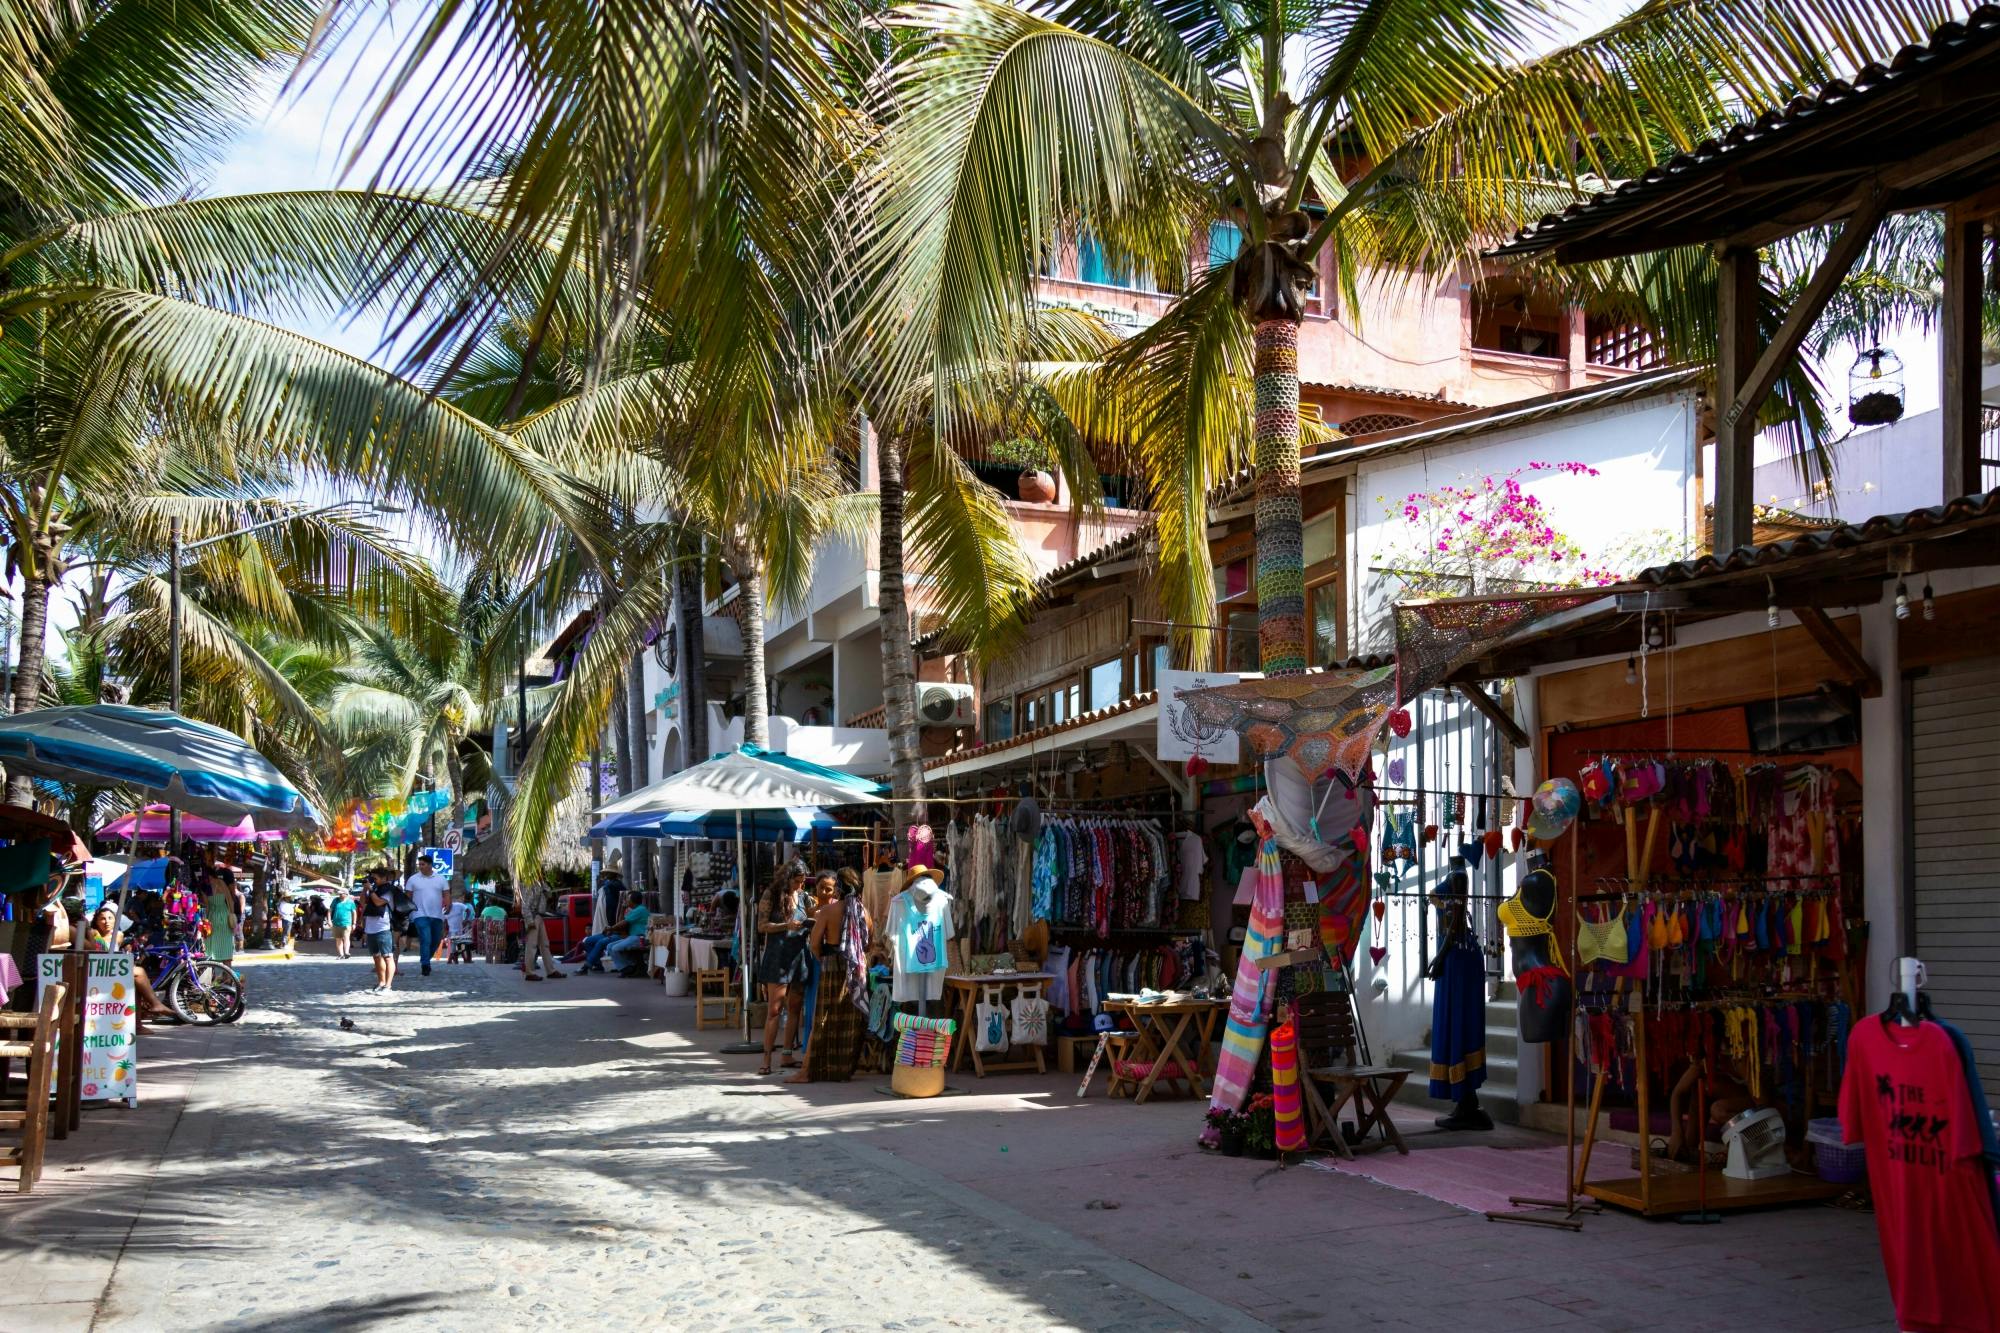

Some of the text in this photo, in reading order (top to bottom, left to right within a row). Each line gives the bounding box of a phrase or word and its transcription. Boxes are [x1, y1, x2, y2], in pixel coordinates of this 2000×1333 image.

[42, 958, 129, 977] SMTHIES
[87, 1003, 126, 1016] BERRY
[82, 1034, 124, 1048] RMELON
[1898, 1083, 1925, 1105] THE
